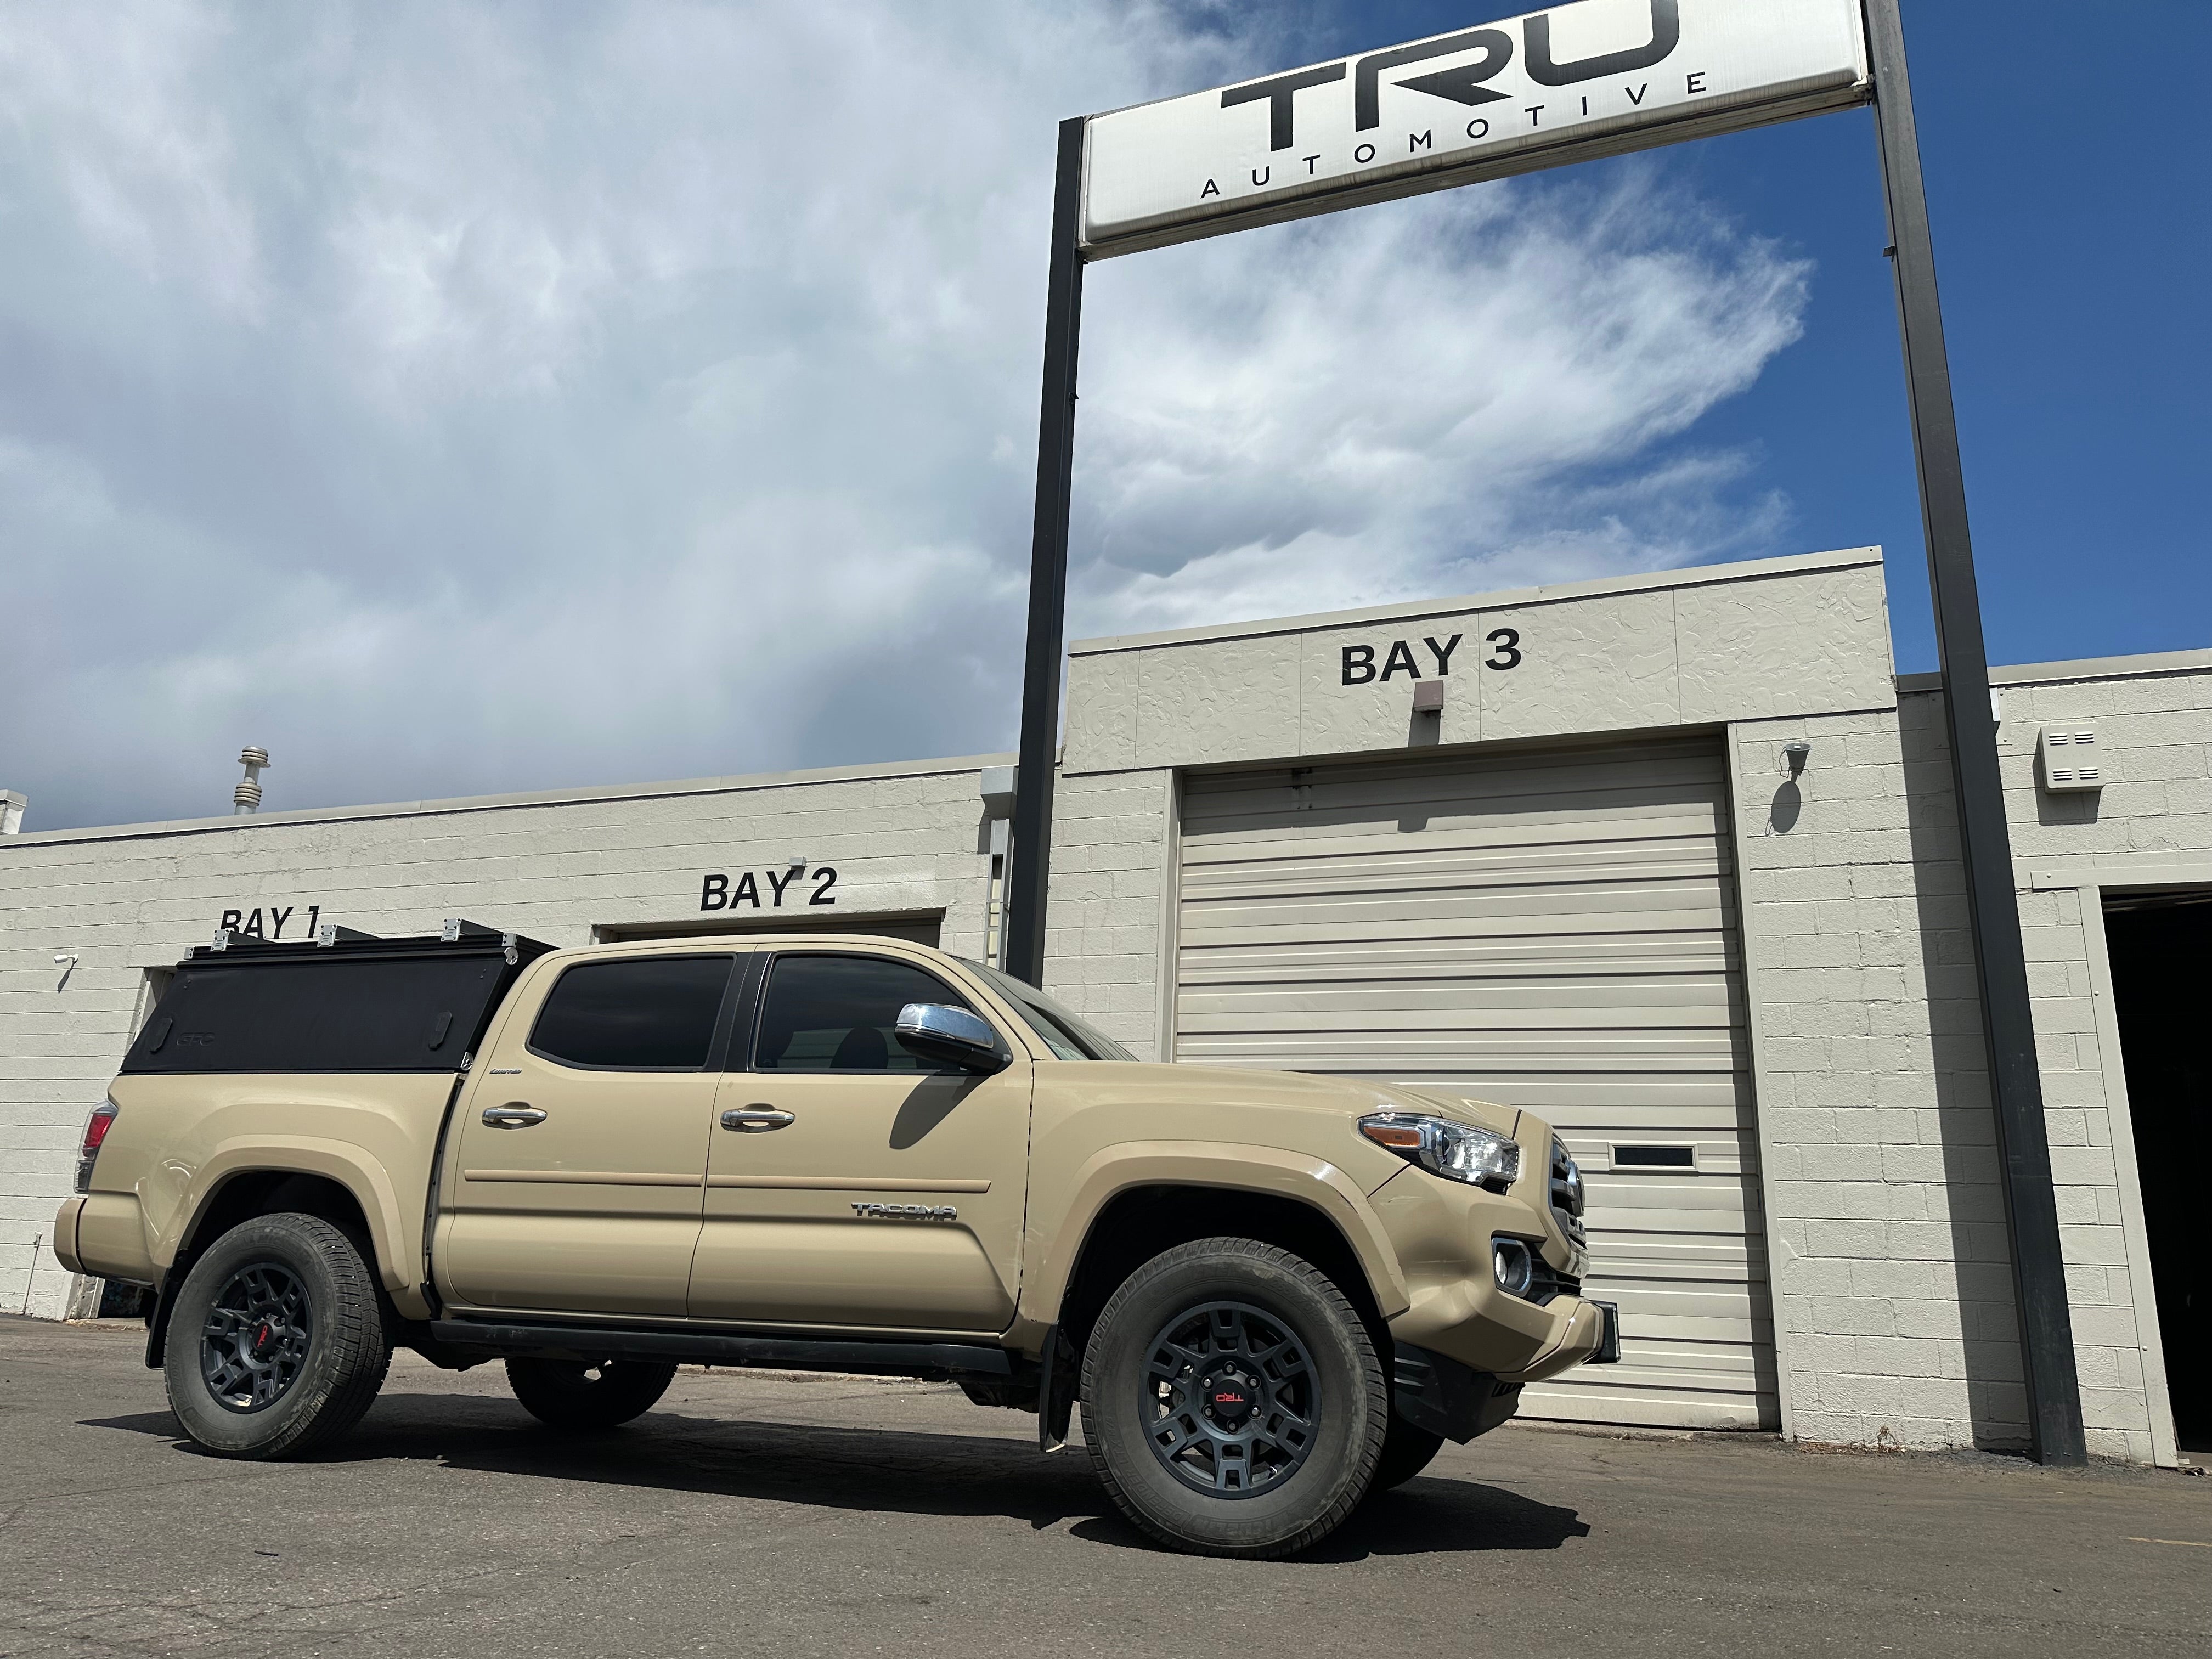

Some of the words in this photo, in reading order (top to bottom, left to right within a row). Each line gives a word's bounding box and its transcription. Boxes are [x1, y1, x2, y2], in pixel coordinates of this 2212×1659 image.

[1221, 0, 1680, 152] TRU
[1200, 71, 1707, 199] AUTOMOTIVE
[1342, 634, 1464, 686] BAY
[1485, 628, 1521, 670] 3
[701, 870, 796, 911] BAY
[809, 867, 837, 905] 2
[221, 906, 294, 939] BAY
[308, 905, 319, 938] 1
[851, 1202, 957, 1219] TACOMA
[1216, 1392, 1244, 1401] TRD
